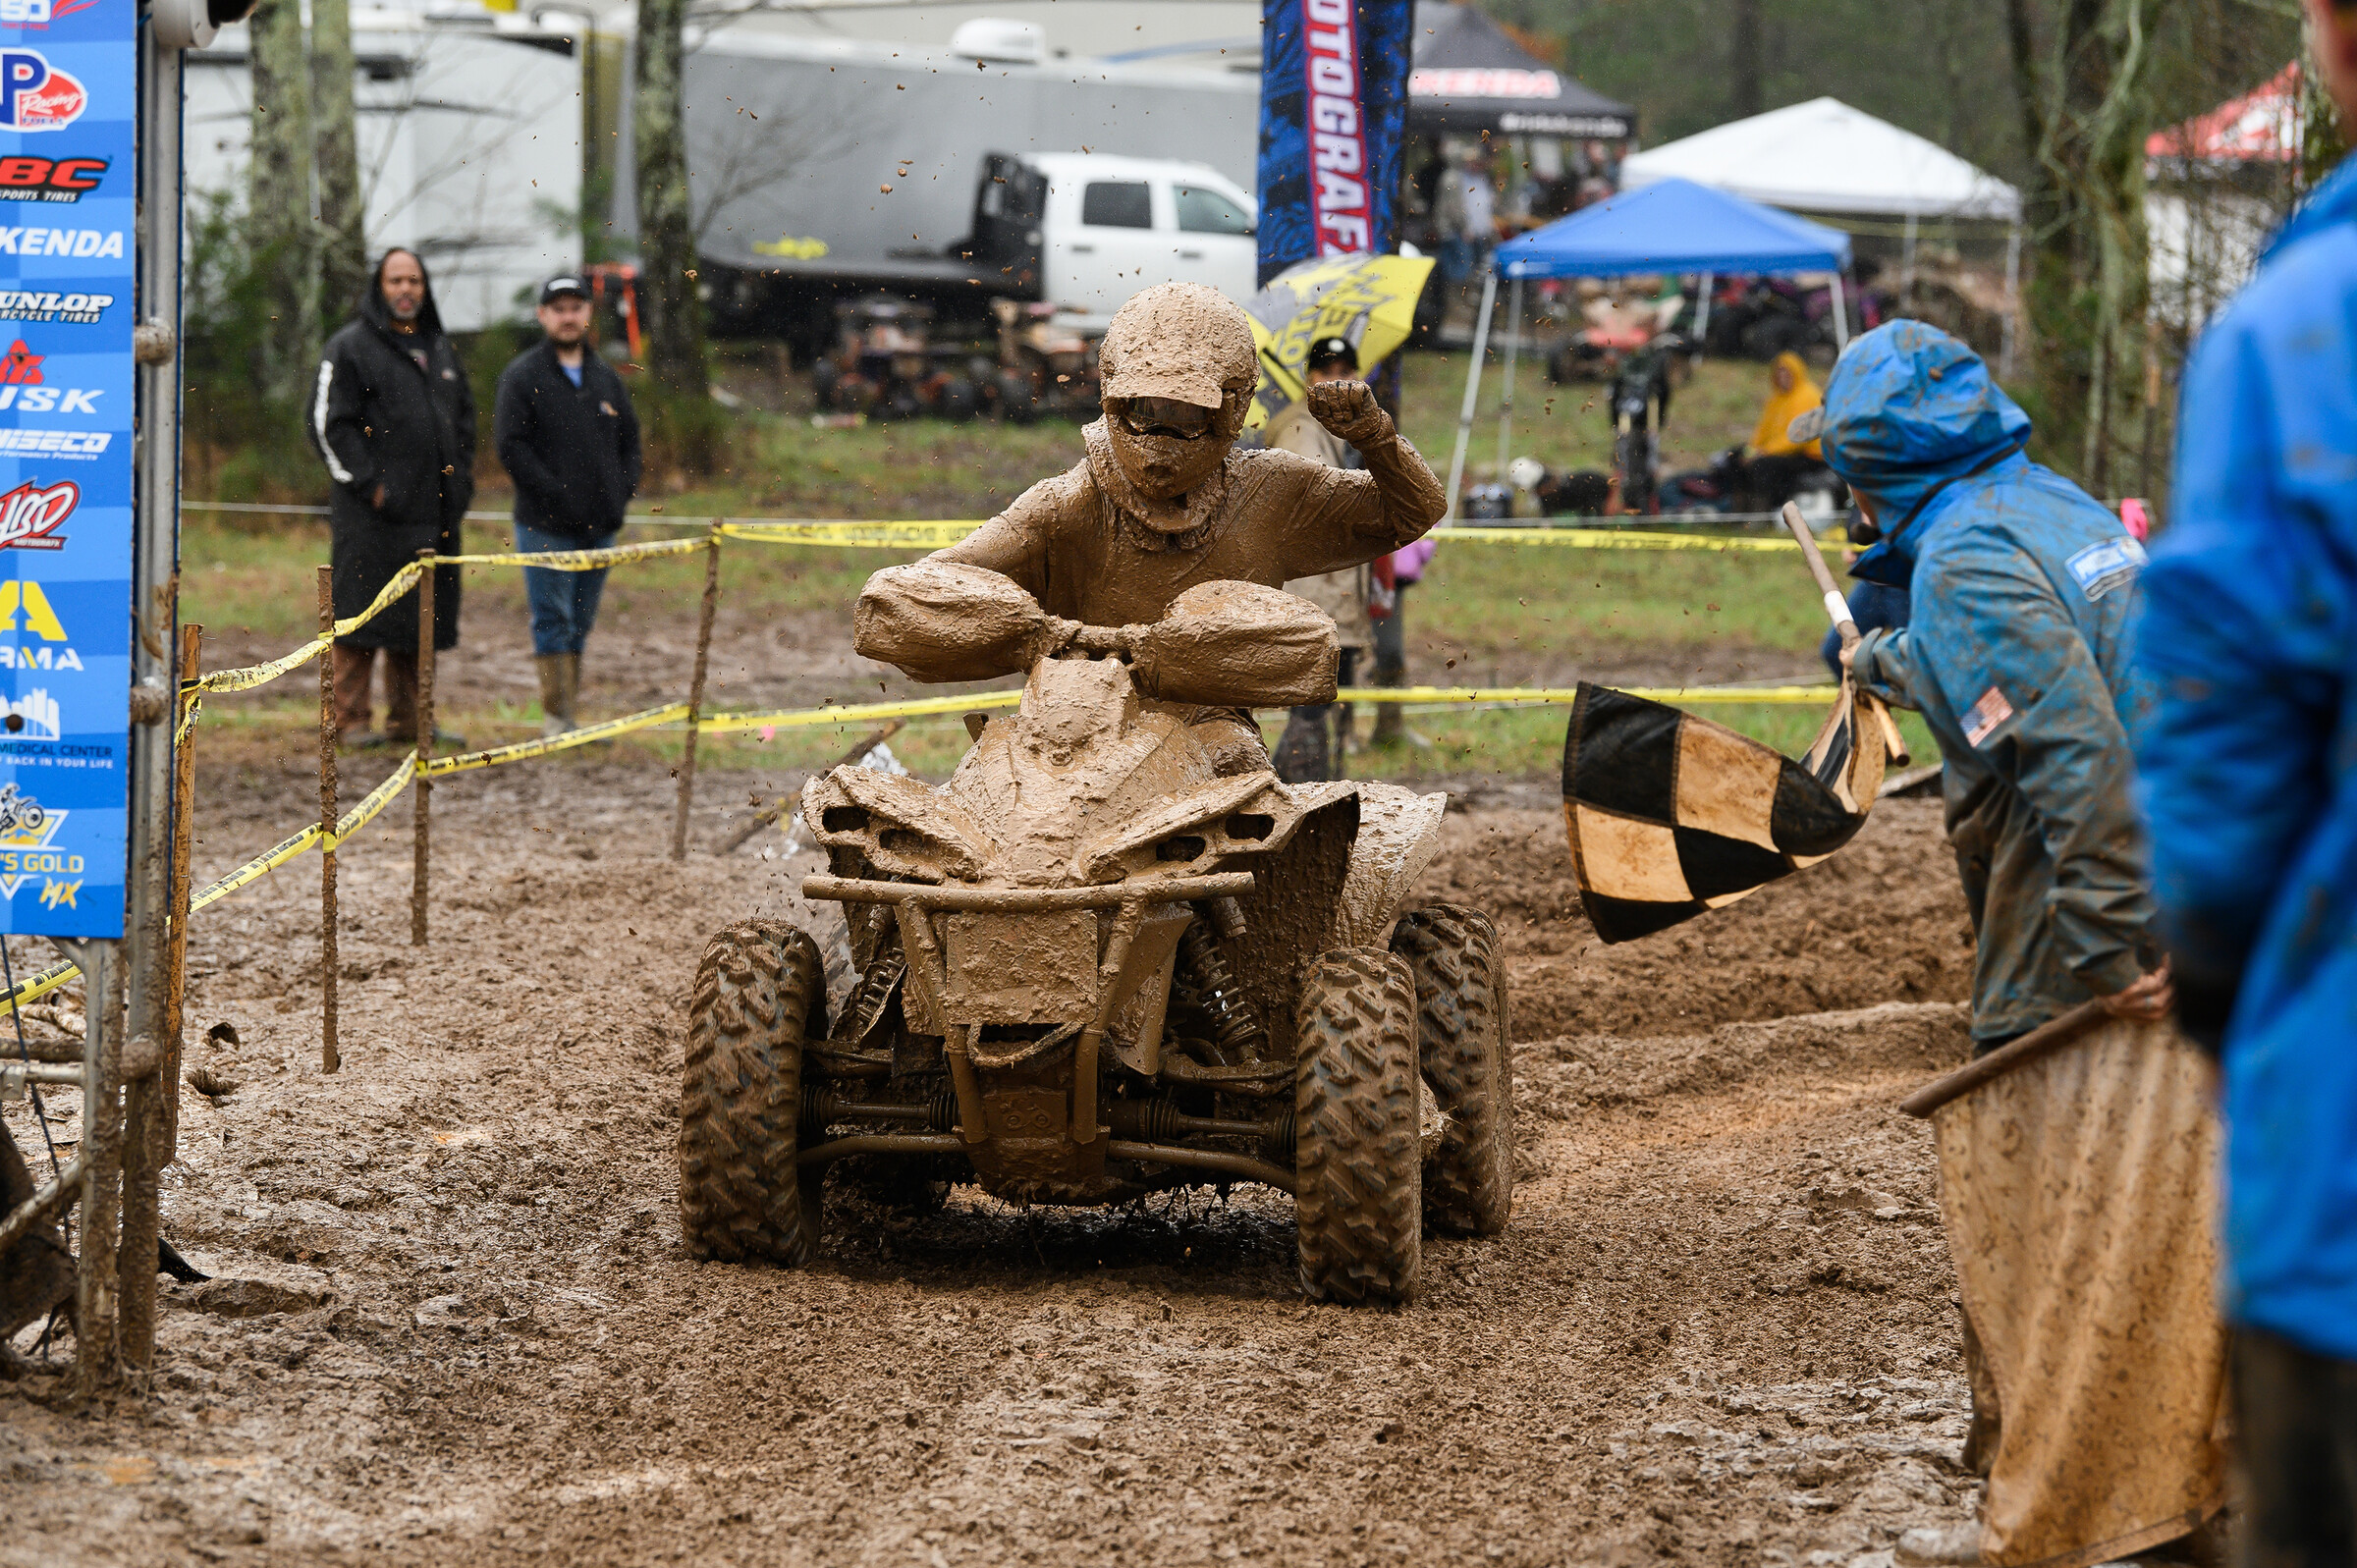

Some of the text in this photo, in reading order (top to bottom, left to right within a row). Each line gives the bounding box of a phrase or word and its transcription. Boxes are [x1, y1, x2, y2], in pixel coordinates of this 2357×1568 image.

[0, 54, 45, 126] P
[22, 92, 83, 115] Racing
[1307, 0, 1371, 258] OTOGRAF
[43, 190, 78, 203] TIRES
[0, 226, 124, 259] KENDA
[59, 312, 100, 324] TIRES
[60, 745, 113, 758] CENTER
[7, 757, 35, 766] BACK
[56, 759, 86, 768] YOUR
[89, 760, 113, 769] LIFE
[24, 853, 84, 874] GOLD
[39, 876, 84, 911] MX
